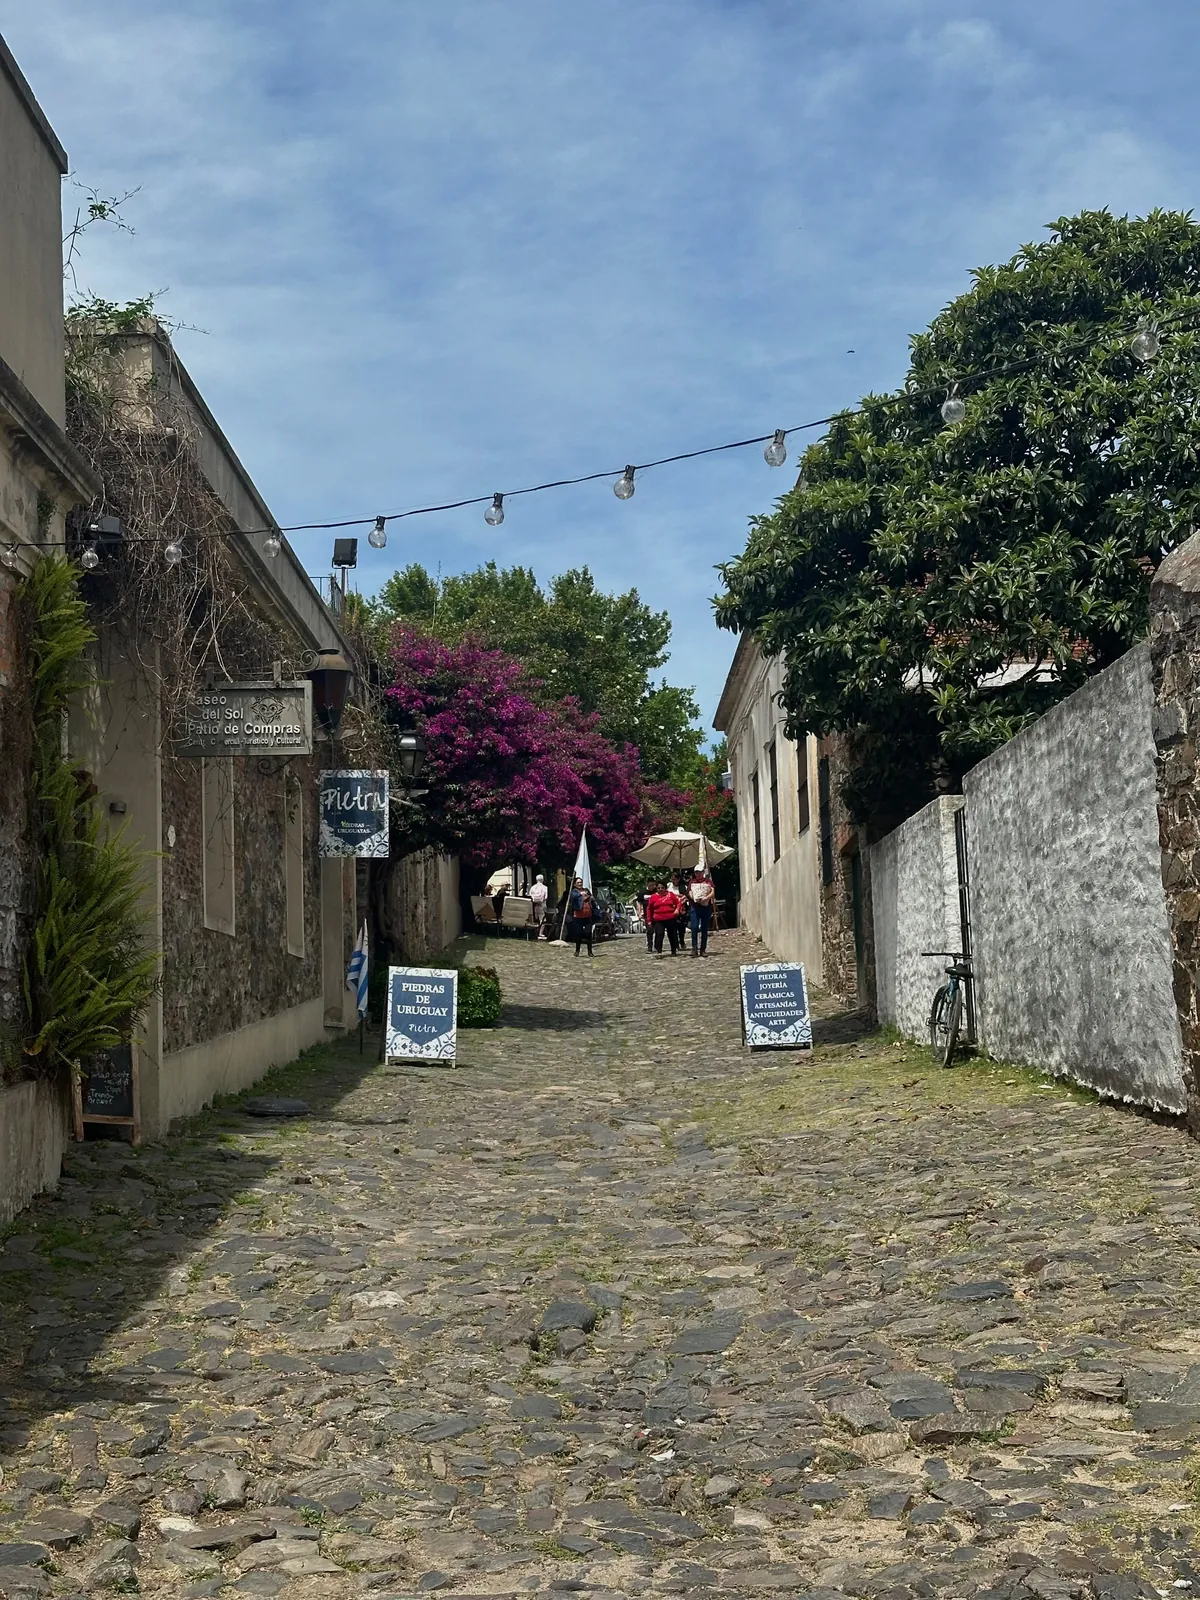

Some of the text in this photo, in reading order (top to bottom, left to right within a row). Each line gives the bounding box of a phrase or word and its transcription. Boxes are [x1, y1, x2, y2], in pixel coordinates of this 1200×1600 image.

[189, 695, 227, 705] aseo
[202, 707, 244, 719] del Sol
[188, 722, 301, 736] Patio de Compras
[276, 736, 301, 744] Cultural
[757, 973, 787, 981] PIEDRAS
[401, 982, 445, 993] PIEDRAS
[759, 982, 788, 990] JOYERÍA
[415, 994, 430, 1004] DE
[754, 992, 795, 1000] CERÁMICAS
[396, 1004, 448, 1016] URUGUAY
[754, 1001, 798, 1009] ARTESANÍAS
[408, 1023, 438, 1033] Pietra
